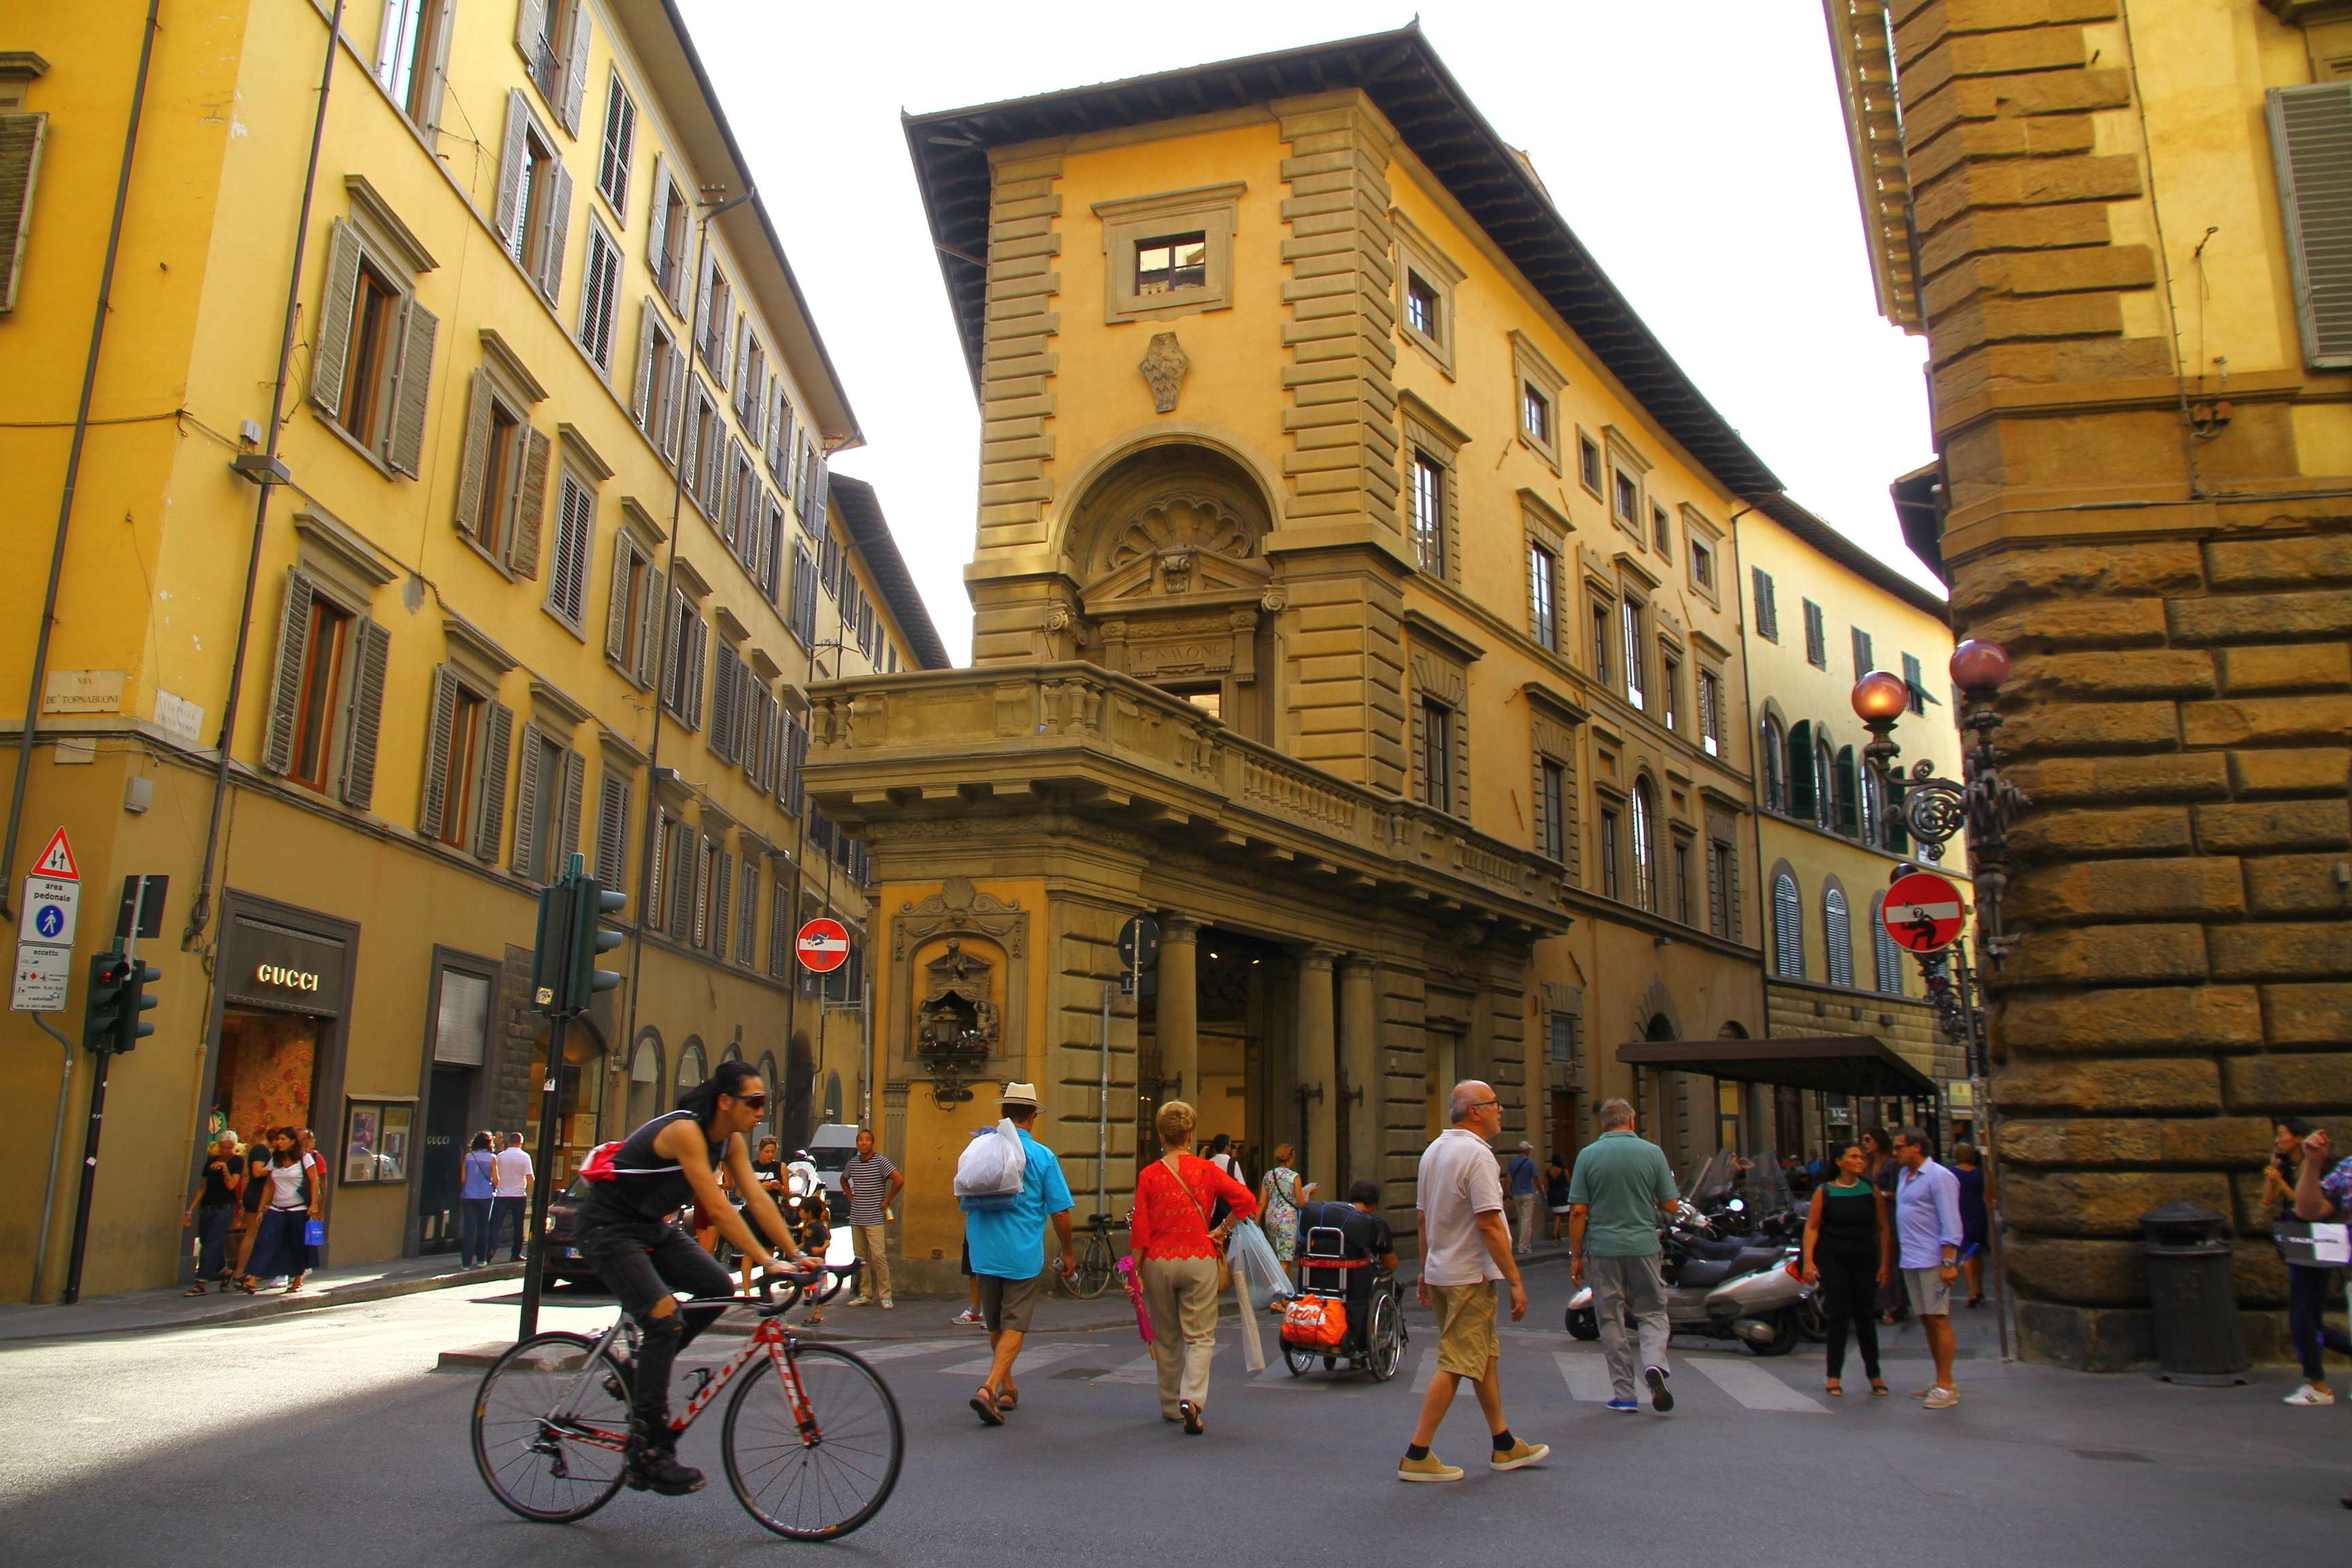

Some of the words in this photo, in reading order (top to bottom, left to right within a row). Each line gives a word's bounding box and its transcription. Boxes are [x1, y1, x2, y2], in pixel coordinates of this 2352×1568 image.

[62, 695, 118, 704] TORNABUONI
[46, 883, 63, 891] area
[33, 892, 71, 902] pedonale
[259, 964, 318, 992] GUCCI
[427, 1136, 450, 1145] GUCCI
